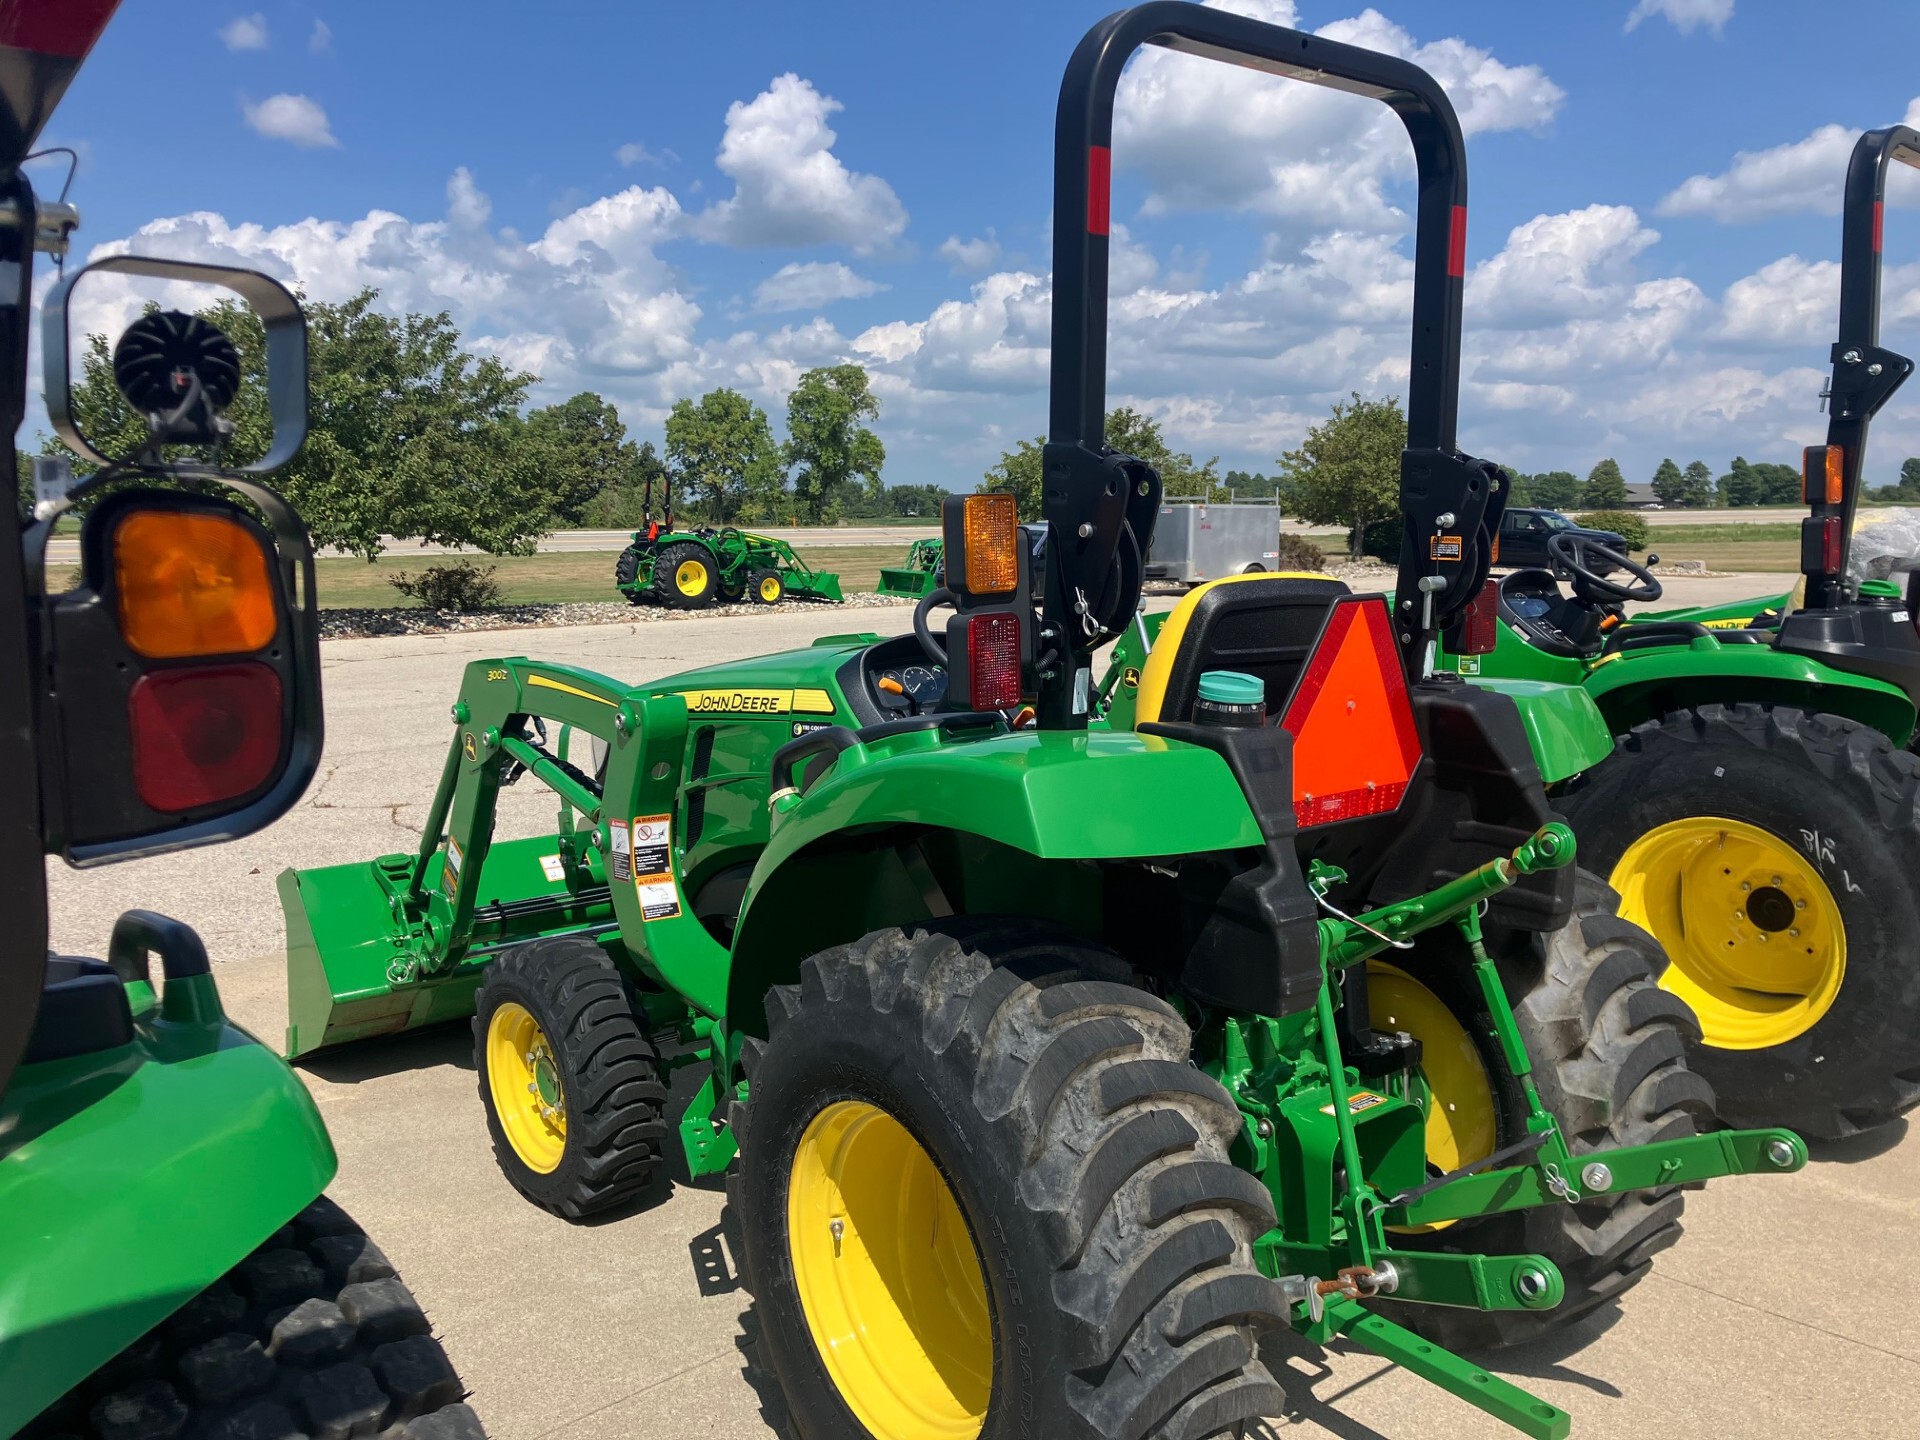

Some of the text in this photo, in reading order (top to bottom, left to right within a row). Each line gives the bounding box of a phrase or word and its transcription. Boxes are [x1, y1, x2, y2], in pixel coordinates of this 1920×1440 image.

[695, 693, 779, 711] JOHN DEERE
[644, 875, 673, 884] WARNING
